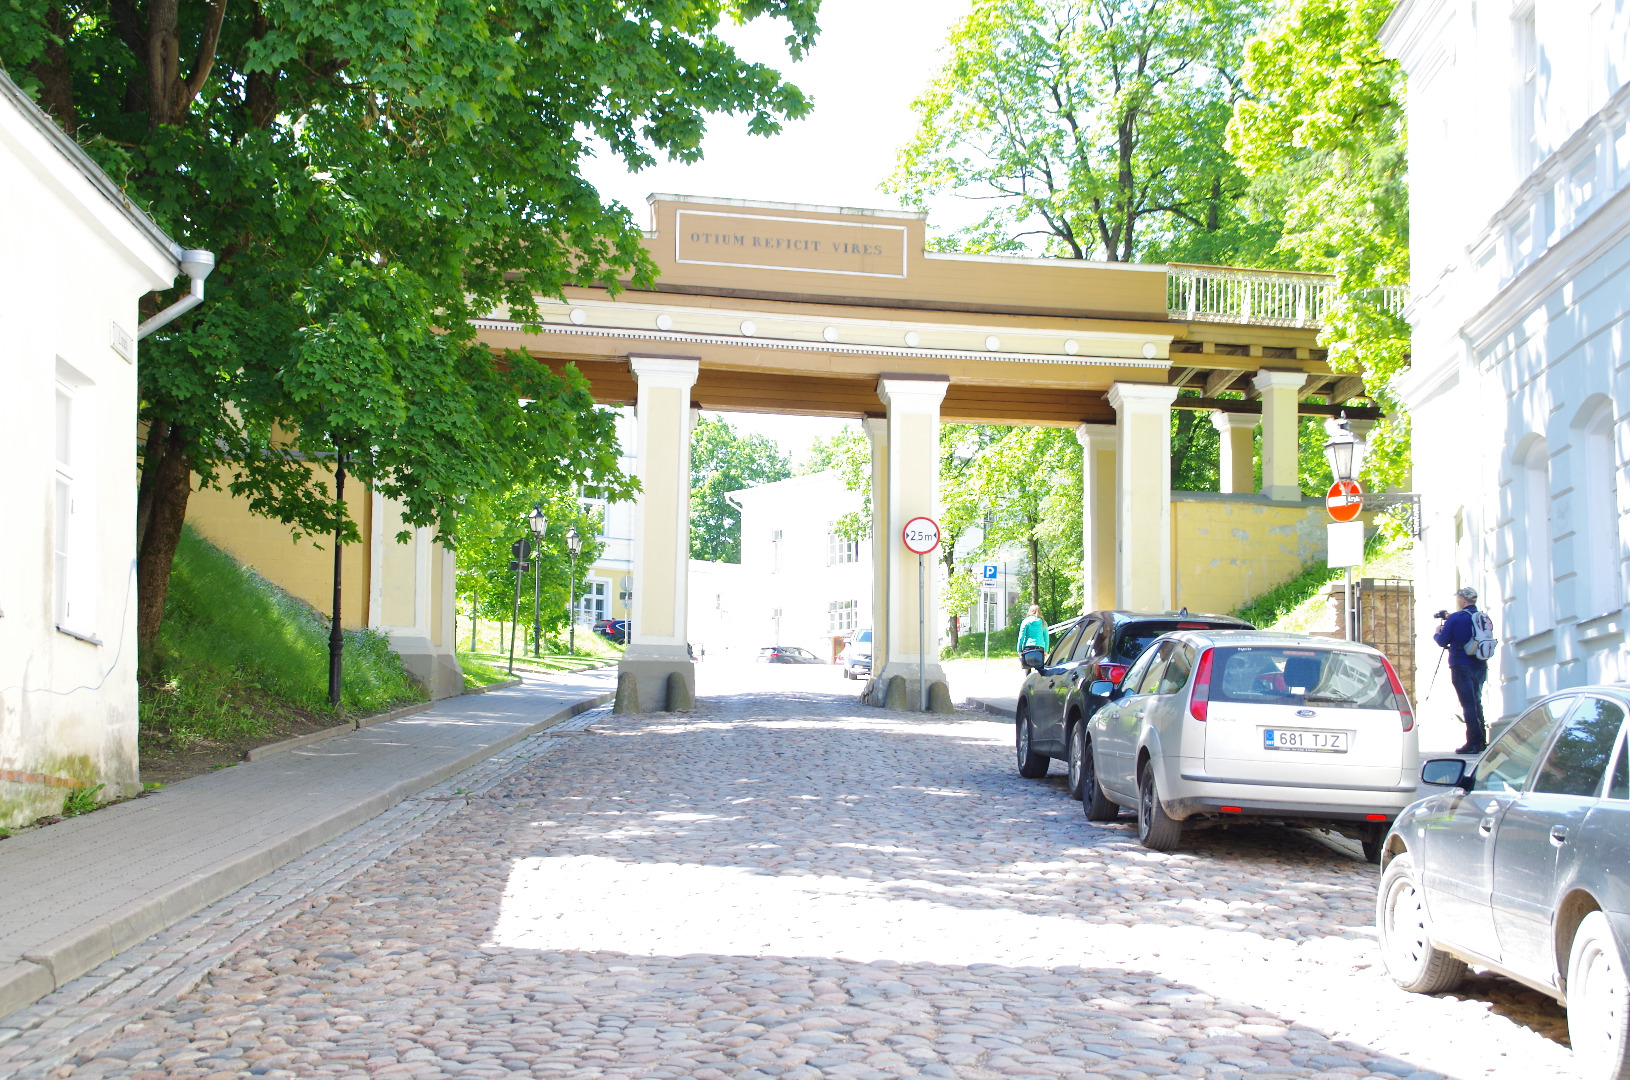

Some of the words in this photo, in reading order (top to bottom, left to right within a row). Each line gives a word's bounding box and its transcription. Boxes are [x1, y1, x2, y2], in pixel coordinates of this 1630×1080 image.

[690, 232, 745, 246] OTIUM
[752, 236, 821, 251] REFICIT
[832, 242, 883, 255] VIRES
[986, 566, 995, 577] P
[1280, 732, 1304, 746] 681
[1312, 734, 1341, 748] TJZ
